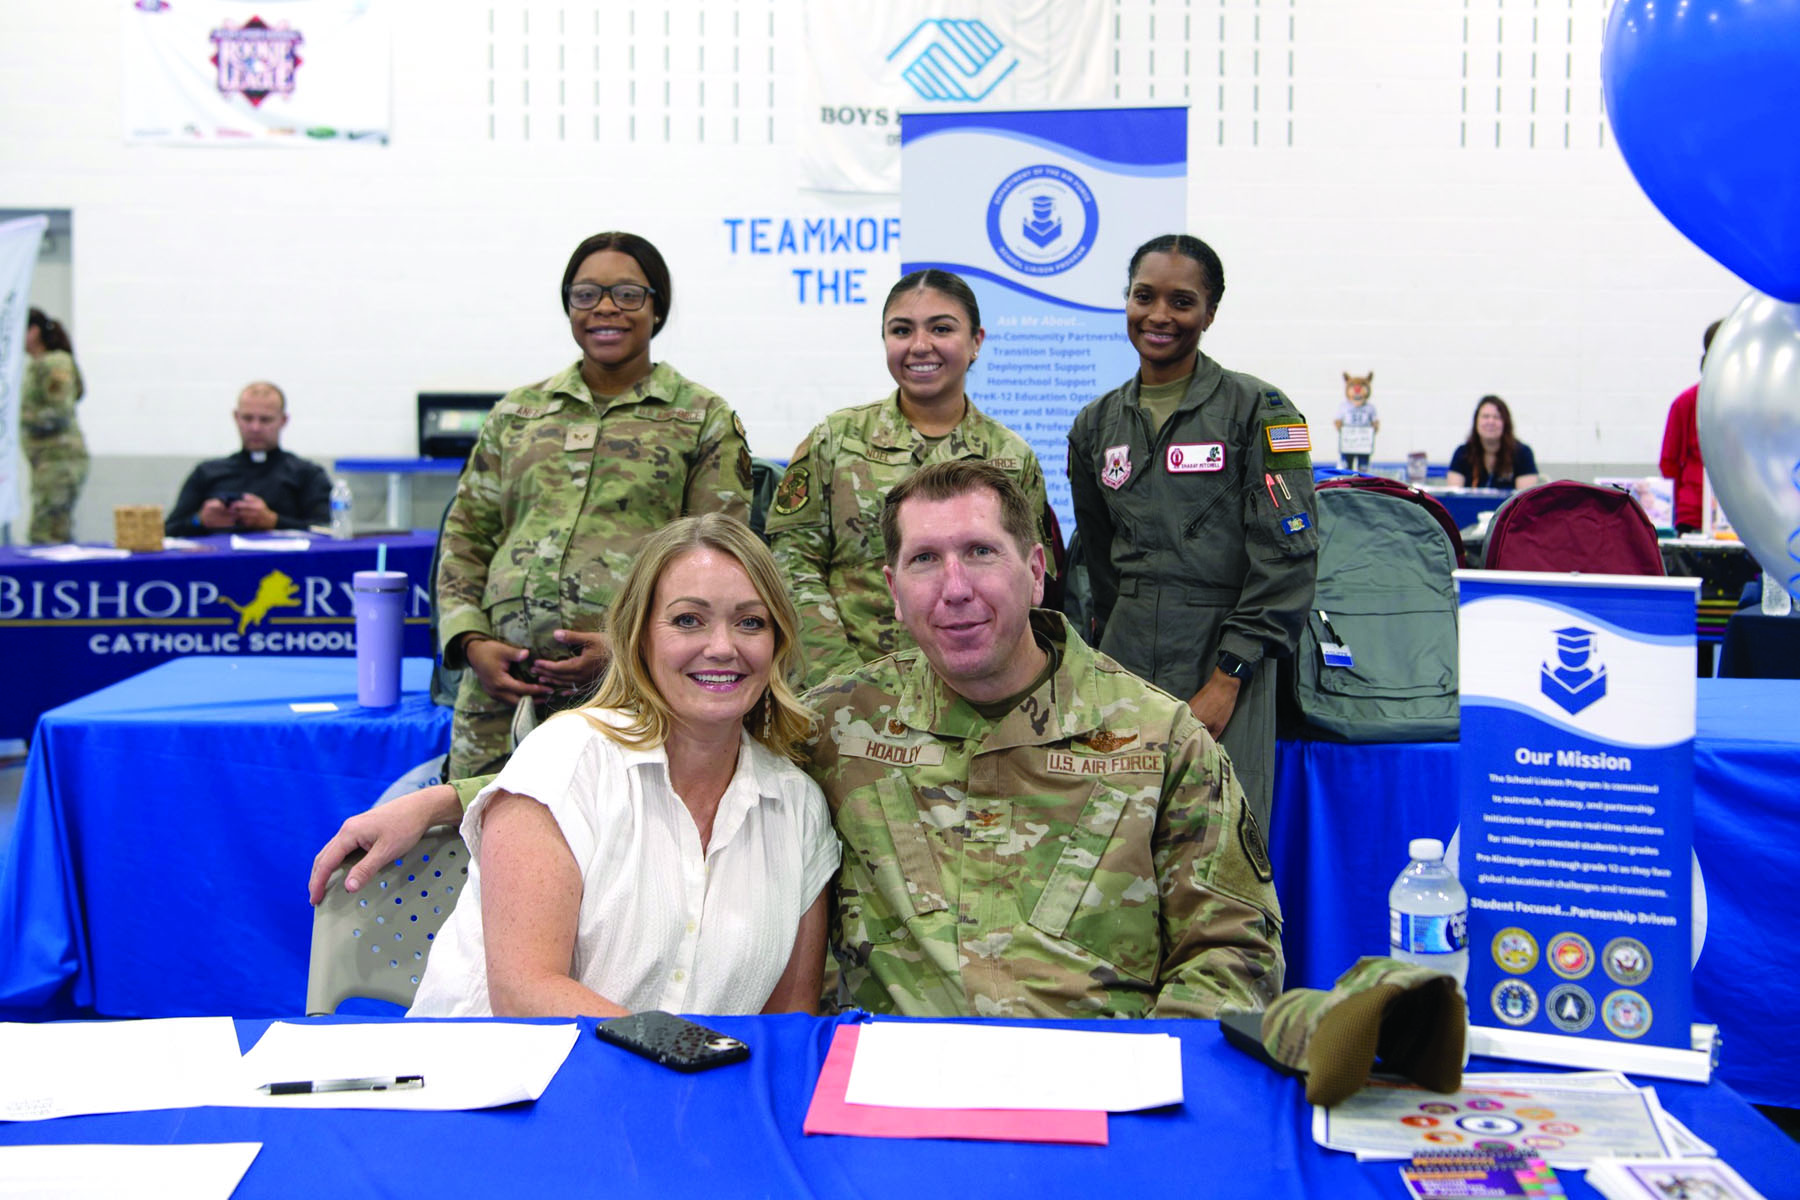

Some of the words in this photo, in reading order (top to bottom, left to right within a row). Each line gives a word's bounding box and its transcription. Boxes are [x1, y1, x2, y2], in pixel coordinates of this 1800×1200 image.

[821, 107, 888, 126] BOYS
[723, 217, 900, 254] TEAMWOR
[792, 269, 867, 304] THE
[997, 316, 1017, 326] Ask
[1021, 316, 1036, 326] Me
[993, 347, 1047, 356] Transition
[1050, 347, 1091, 358] Support
[987, 362, 1051, 373] Deployment
[1054, 362, 1096, 373] Support
[987, 377, 1052, 387] Homeschool
[1054, 378, 1096, 388] Support
[1015, 392, 1067, 401] Education
[985, 407, 1020, 416] Career
[1022, 407, 1043, 416] and
[865, 449, 890, 463] NOEL
[0, 575, 219, 620] BISHOP
[89, 632, 240, 654] CATHOLIC
[249, 630, 357, 652] SCHOOL
[865, 740, 922, 764] HOADLEY
[1515, 747, 1553, 766] Our
[1556, 749, 1632, 771] Mission
[1049, 753, 1076, 772] U.S.
[1081, 754, 1107, 774] AIR
[1112, 753, 1162, 772] FORCE
[1489, 773, 1505, 783] The
[1506, 774, 1533, 785] School
[1534, 776, 1564, 787] Liaison
[1565, 778, 1602, 791] Program
[1612, 782, 1659, 795] committed
[1492, 794, 1502, 803] to
[1586, 801, 1603, 811] and
[1604, 802, 1656, 816] partnership
[1525, 817, 1544, 826] that
[1544, 819, 1583, 829] generate
[1623, 823, 1665, 836] solutions
[1487, 833, 1501, 843] for
[1581, 841, 1619, 853] students
[1628, 845, 1660, 857] grades
[1547, 858, 1580, 872] through
[1582, 861, 1607, 873] grade
[1608, 864, 1619, 873] 12
[1620, 866, 1630, 874] as
[1630, 865, 1651, 877] they
[1651, 867, 1672, 878] face
[1478, 872, 1504, 884] global
[1505, 874, 1554, 888] educational
[1554, 879, 1600, 893] challenges
[1600, 884, 1618, 894] and
[1471, 897, 1515, 913] Student
[1637, 911, 1677, 927] Driven
